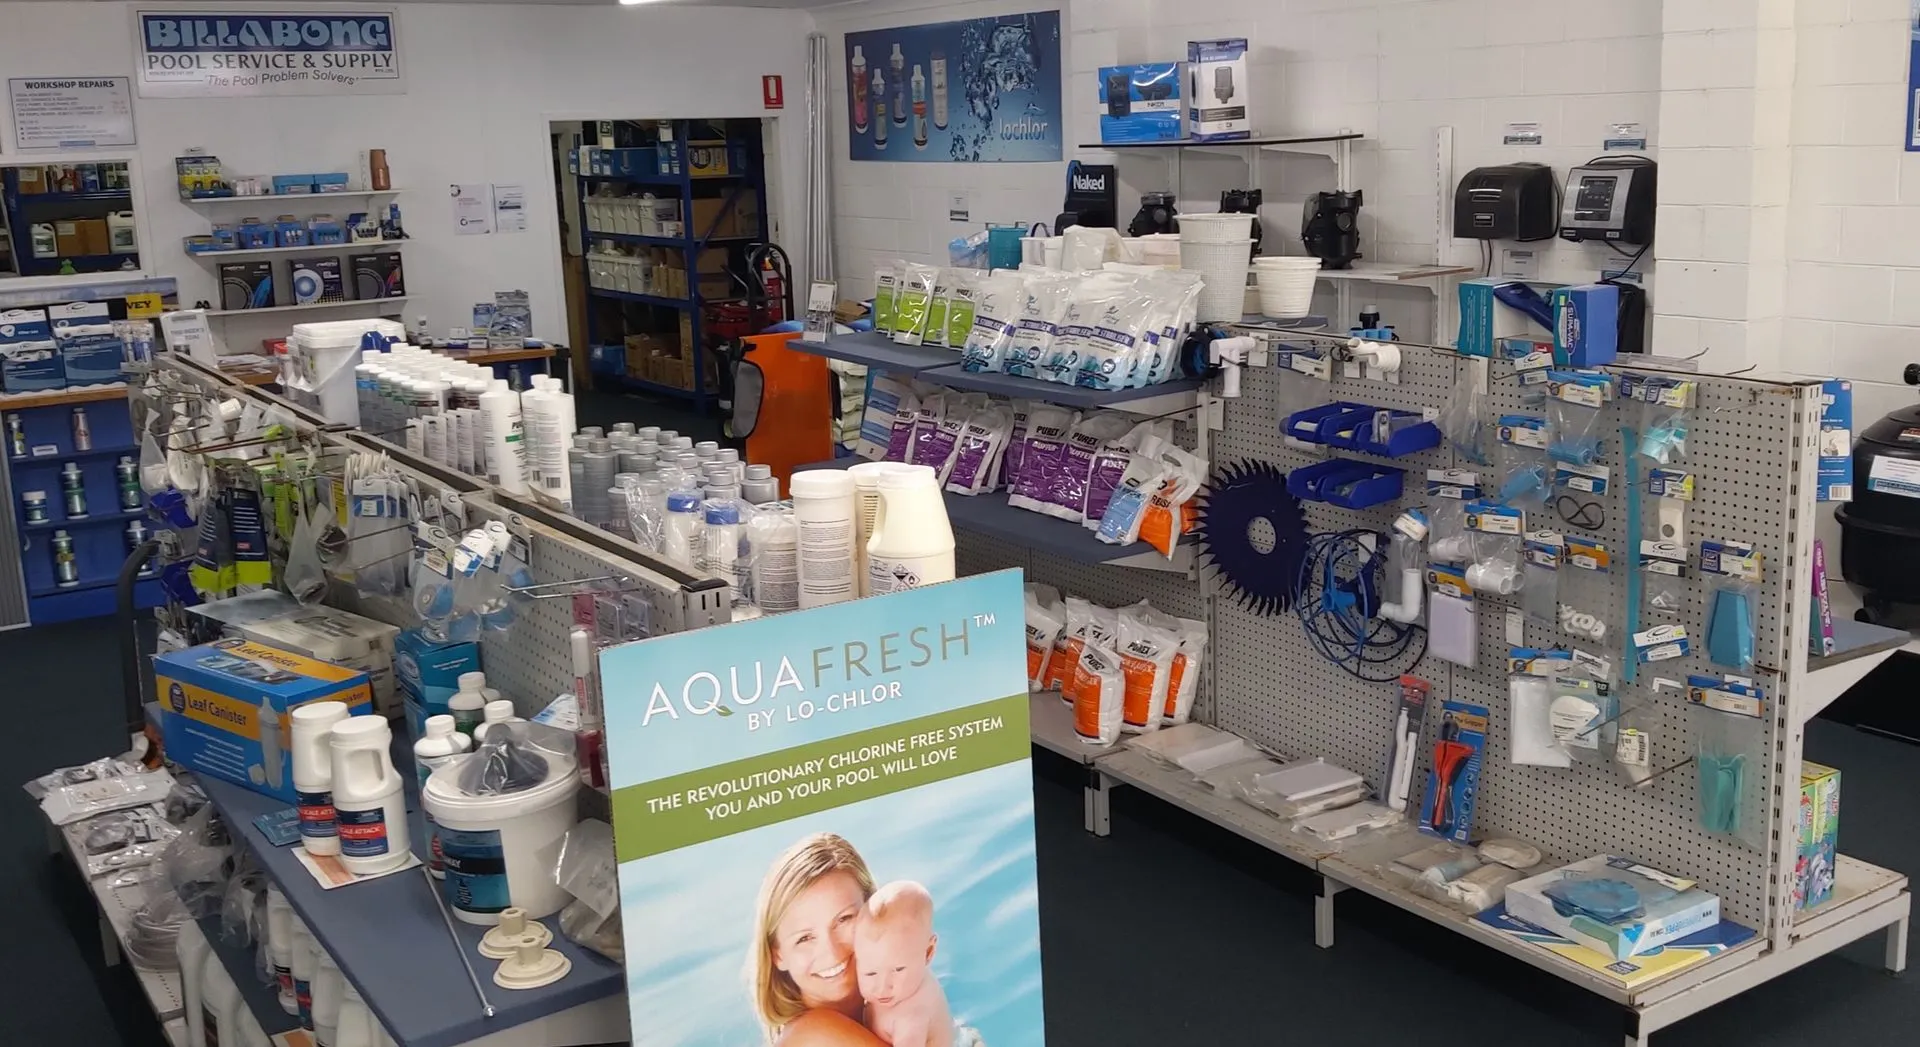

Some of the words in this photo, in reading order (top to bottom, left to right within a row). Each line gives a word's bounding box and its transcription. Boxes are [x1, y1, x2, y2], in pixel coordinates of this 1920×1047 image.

[147, 19, 388, 48] BILLABONG
[149, 53, 208, 70] POOL
[212, 53, 297, 69] SERVICE
[302, 54, 317, 68] &
[322, 53, 393, 68] SUPPLY
[25, 80, 76, 90] WORKSHOP
[78, 79, 115, 89] REPAIRS
[232, 74, 258, 86] Pool
[261, 69, 309, 84] Problem
[999, 117, 1049, 141] lochlor
[1072, 174, 1105, 191] Naked
[1036, 425, 1060, 438] PUREX
[1071, 432, 1099, 446] PUREX
[1127, 641, 1152, 655] PUREX
[1083, 653, 1105, 671] PUREX
[187, 694, 208, 713] Leaf
[209, 701, 247, 726] Canister
[747, 707, 775, 732] BY
[785, 681, 903, 725] LO-CHLOR
[646, 794, 683, 815] THE
[686, 757, 825, 805] REVOLUTIONARY
[827, 737, 907, 771] CHLORINE
[909, 729, 945, 749] FREE
[947, 715, 1004, 742] SYSTEM
[704, 801, 744, 822] YOU
[746, 789, 784, 812] AND
[786, 777, 833, 802] YOUR
[835, 764, 880, 791] POOL
[881, 756, 918, 777] WILL
[920, 745, 958, 769] LOVE
